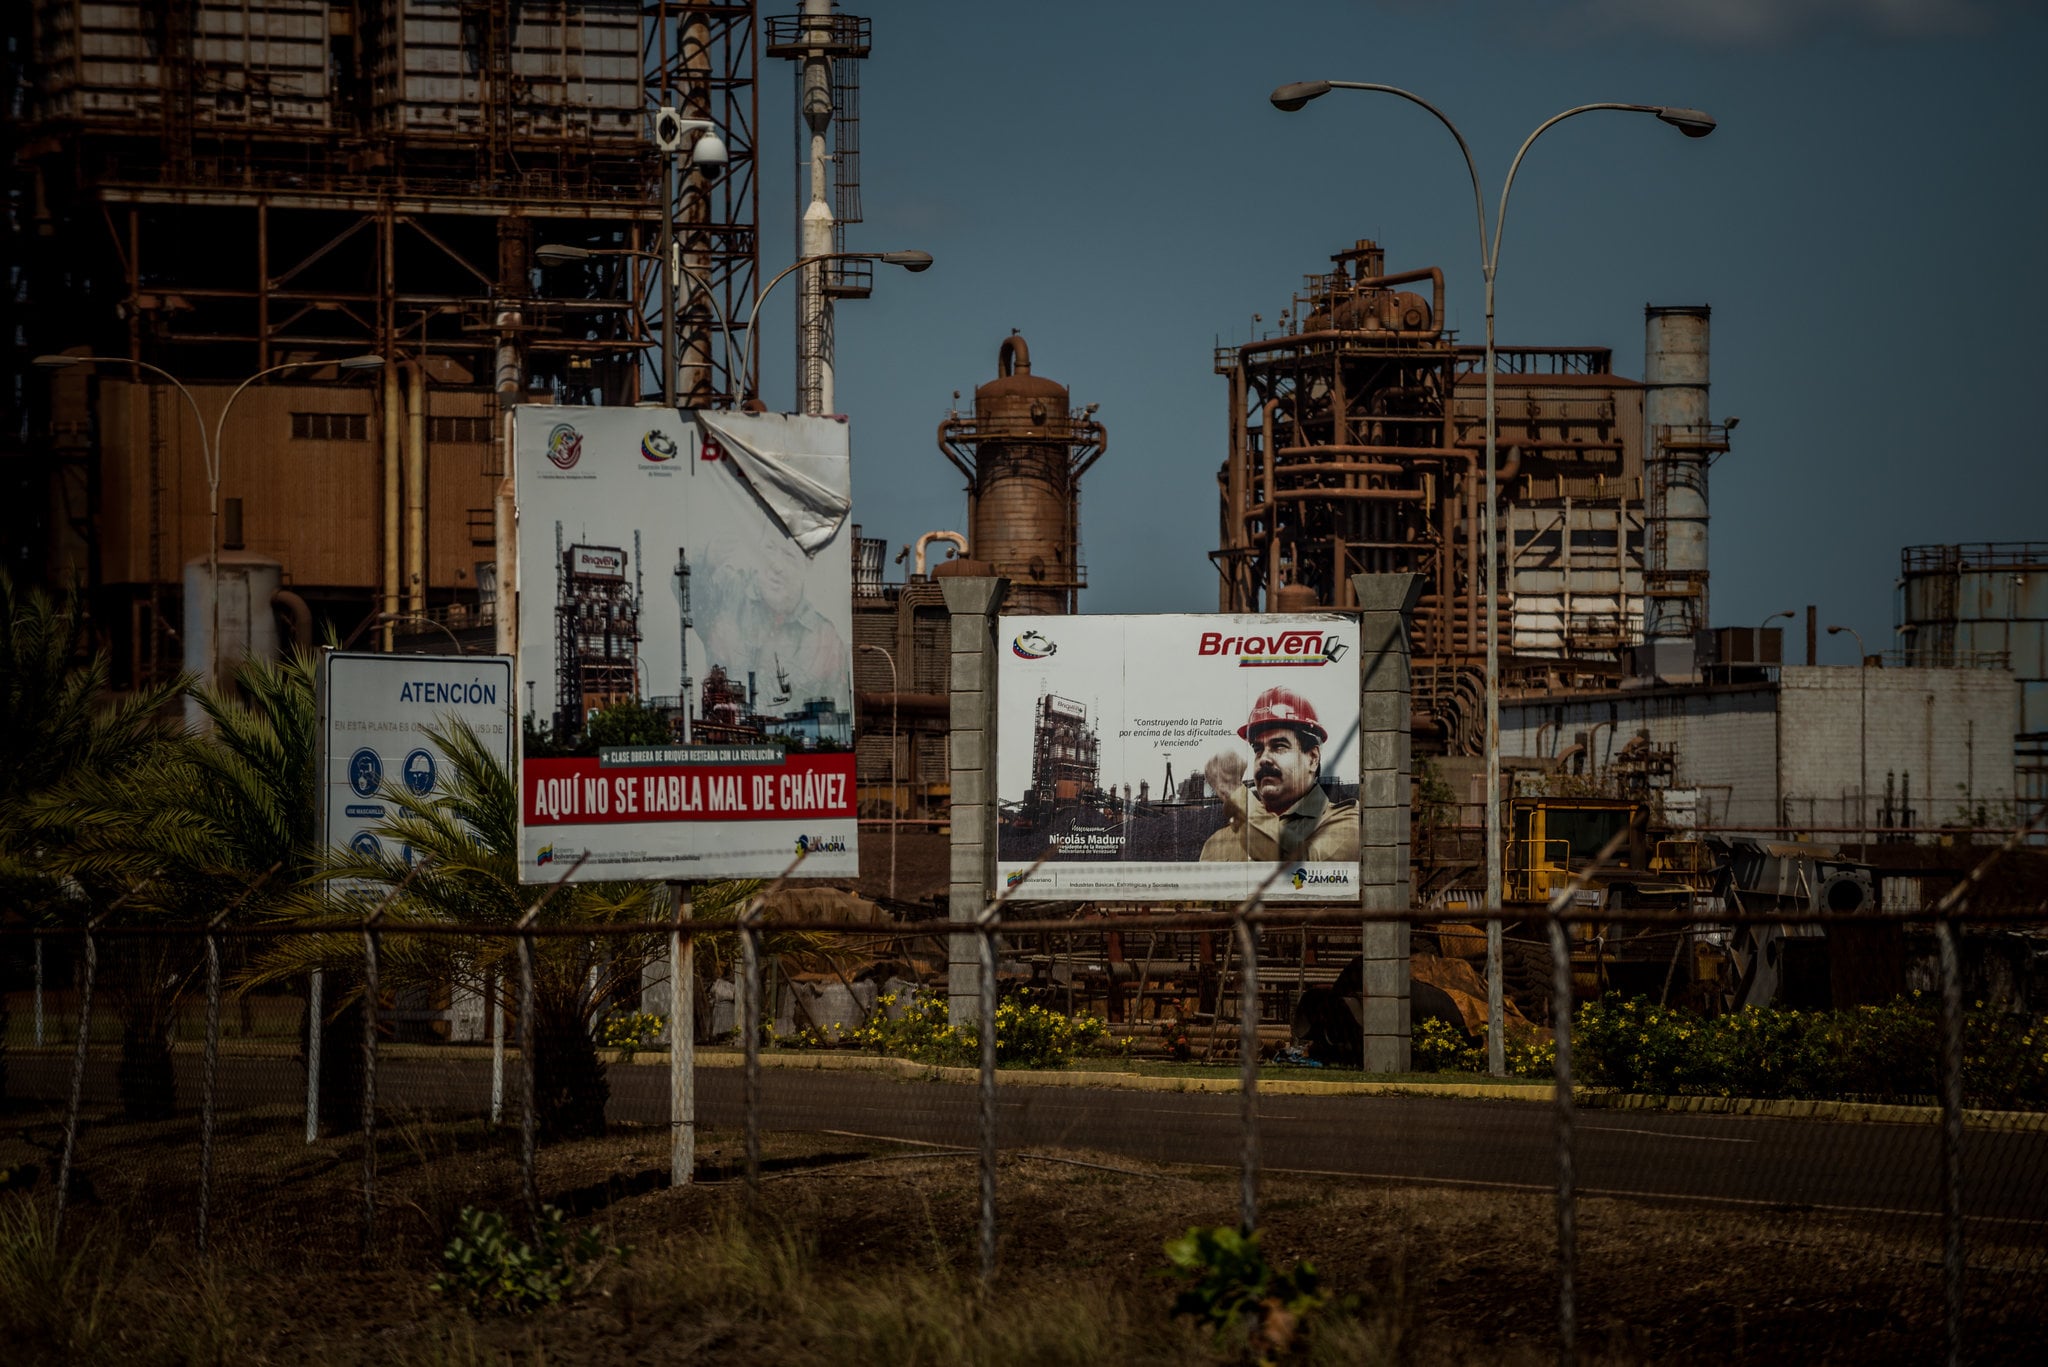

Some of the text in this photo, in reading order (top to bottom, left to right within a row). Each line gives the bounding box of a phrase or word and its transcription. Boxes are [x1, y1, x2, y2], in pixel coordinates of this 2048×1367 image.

[400, 677, 496, 705] ATENCIÓN
[1199, 718, 1223, 726] Patria
[1119, 730, 1131, 738] por
[1133, 728, 1161, 737] encima
[1162, 728, 1172, 737] de
[1173, 728, 1186, 737] las
[1153, 740, 1159, 748] y
[611, 751, 631, 763] CLASE
[631, 750, 654, 763] OBRERA
[654, 750, 664, 762] DE
[719, 749, 732, 761] CON
[732, 749, 740, 761] LA
[535, 768, 848, 820] AQUÍ NO SE HABLA MAL DE CHÁVEZ
[1049, 833, 1127, 844] Nicolás Maduro
[1308, 875, 1349, 884] ZAMORA
